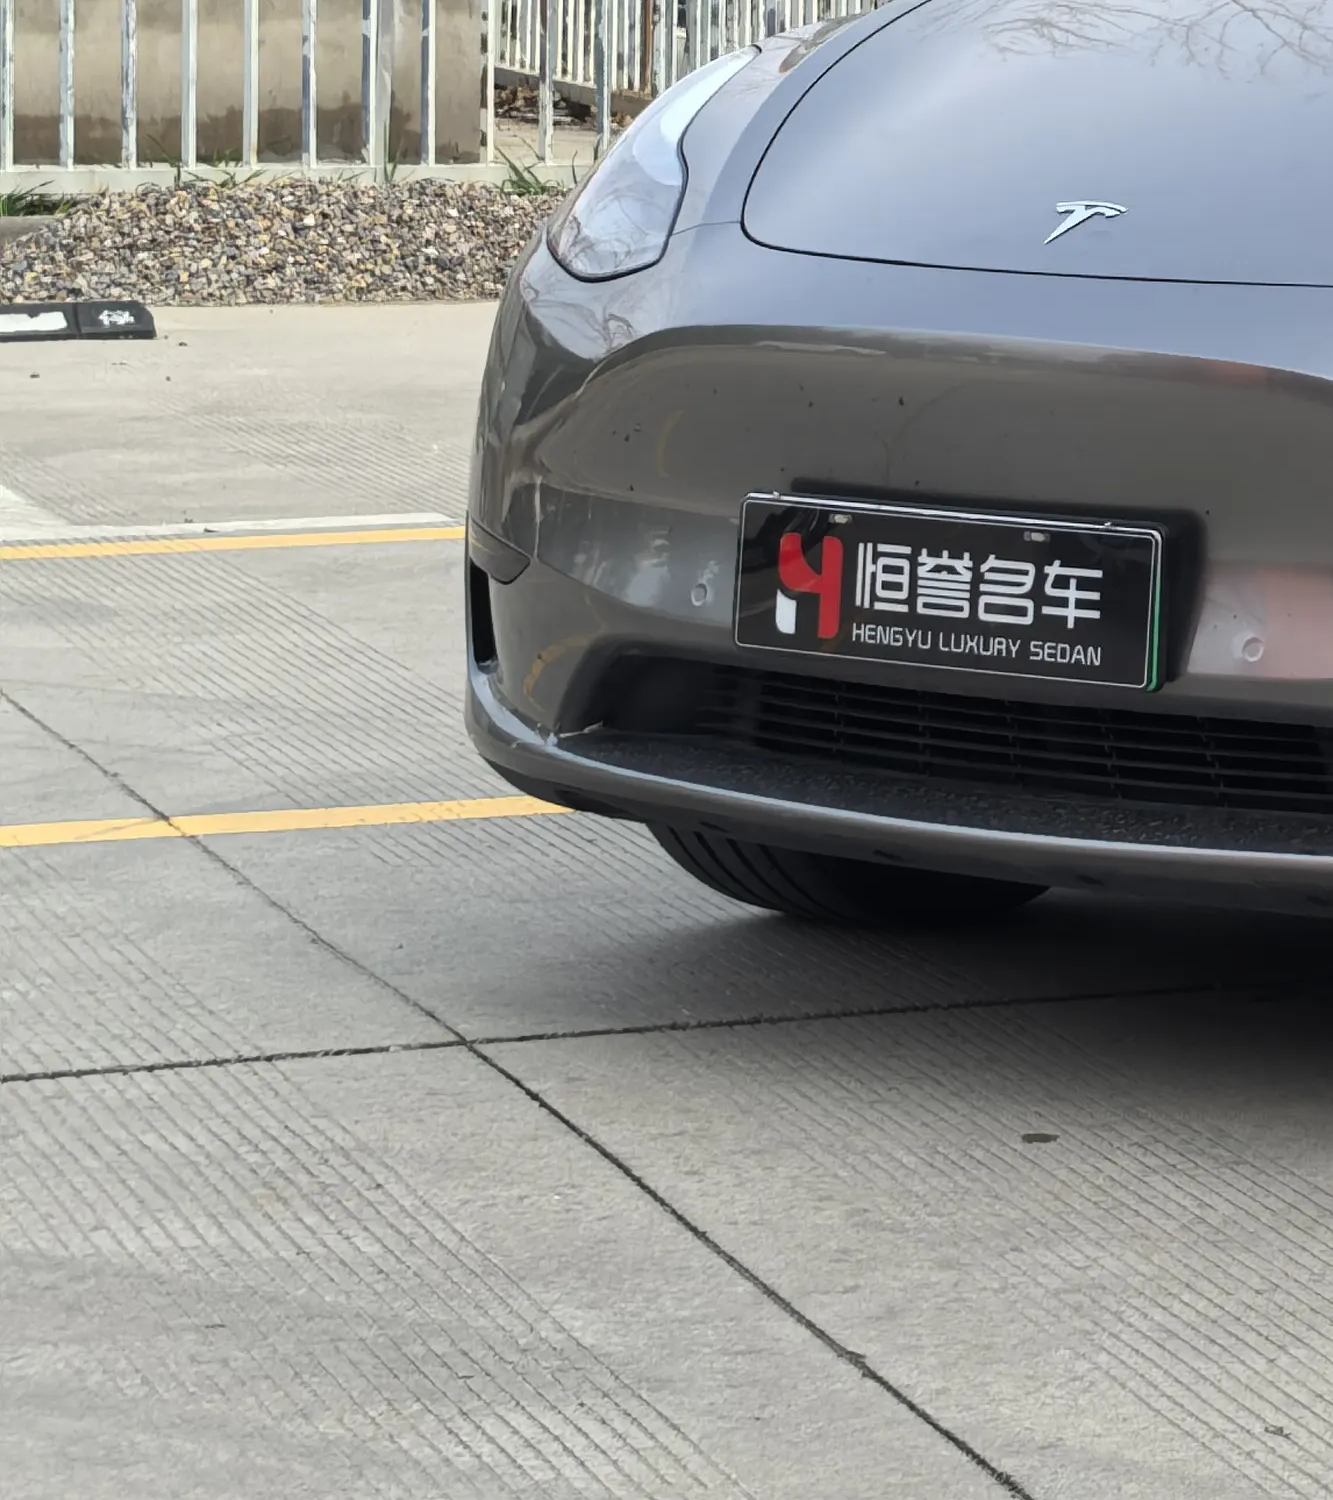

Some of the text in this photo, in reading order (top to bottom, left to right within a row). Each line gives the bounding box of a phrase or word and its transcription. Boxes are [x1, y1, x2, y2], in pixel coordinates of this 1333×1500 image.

[855, 542, 1104, 630] 恒誉名车
[852, 622, 1102, 666] HENGYU LUXURY SEDAN
